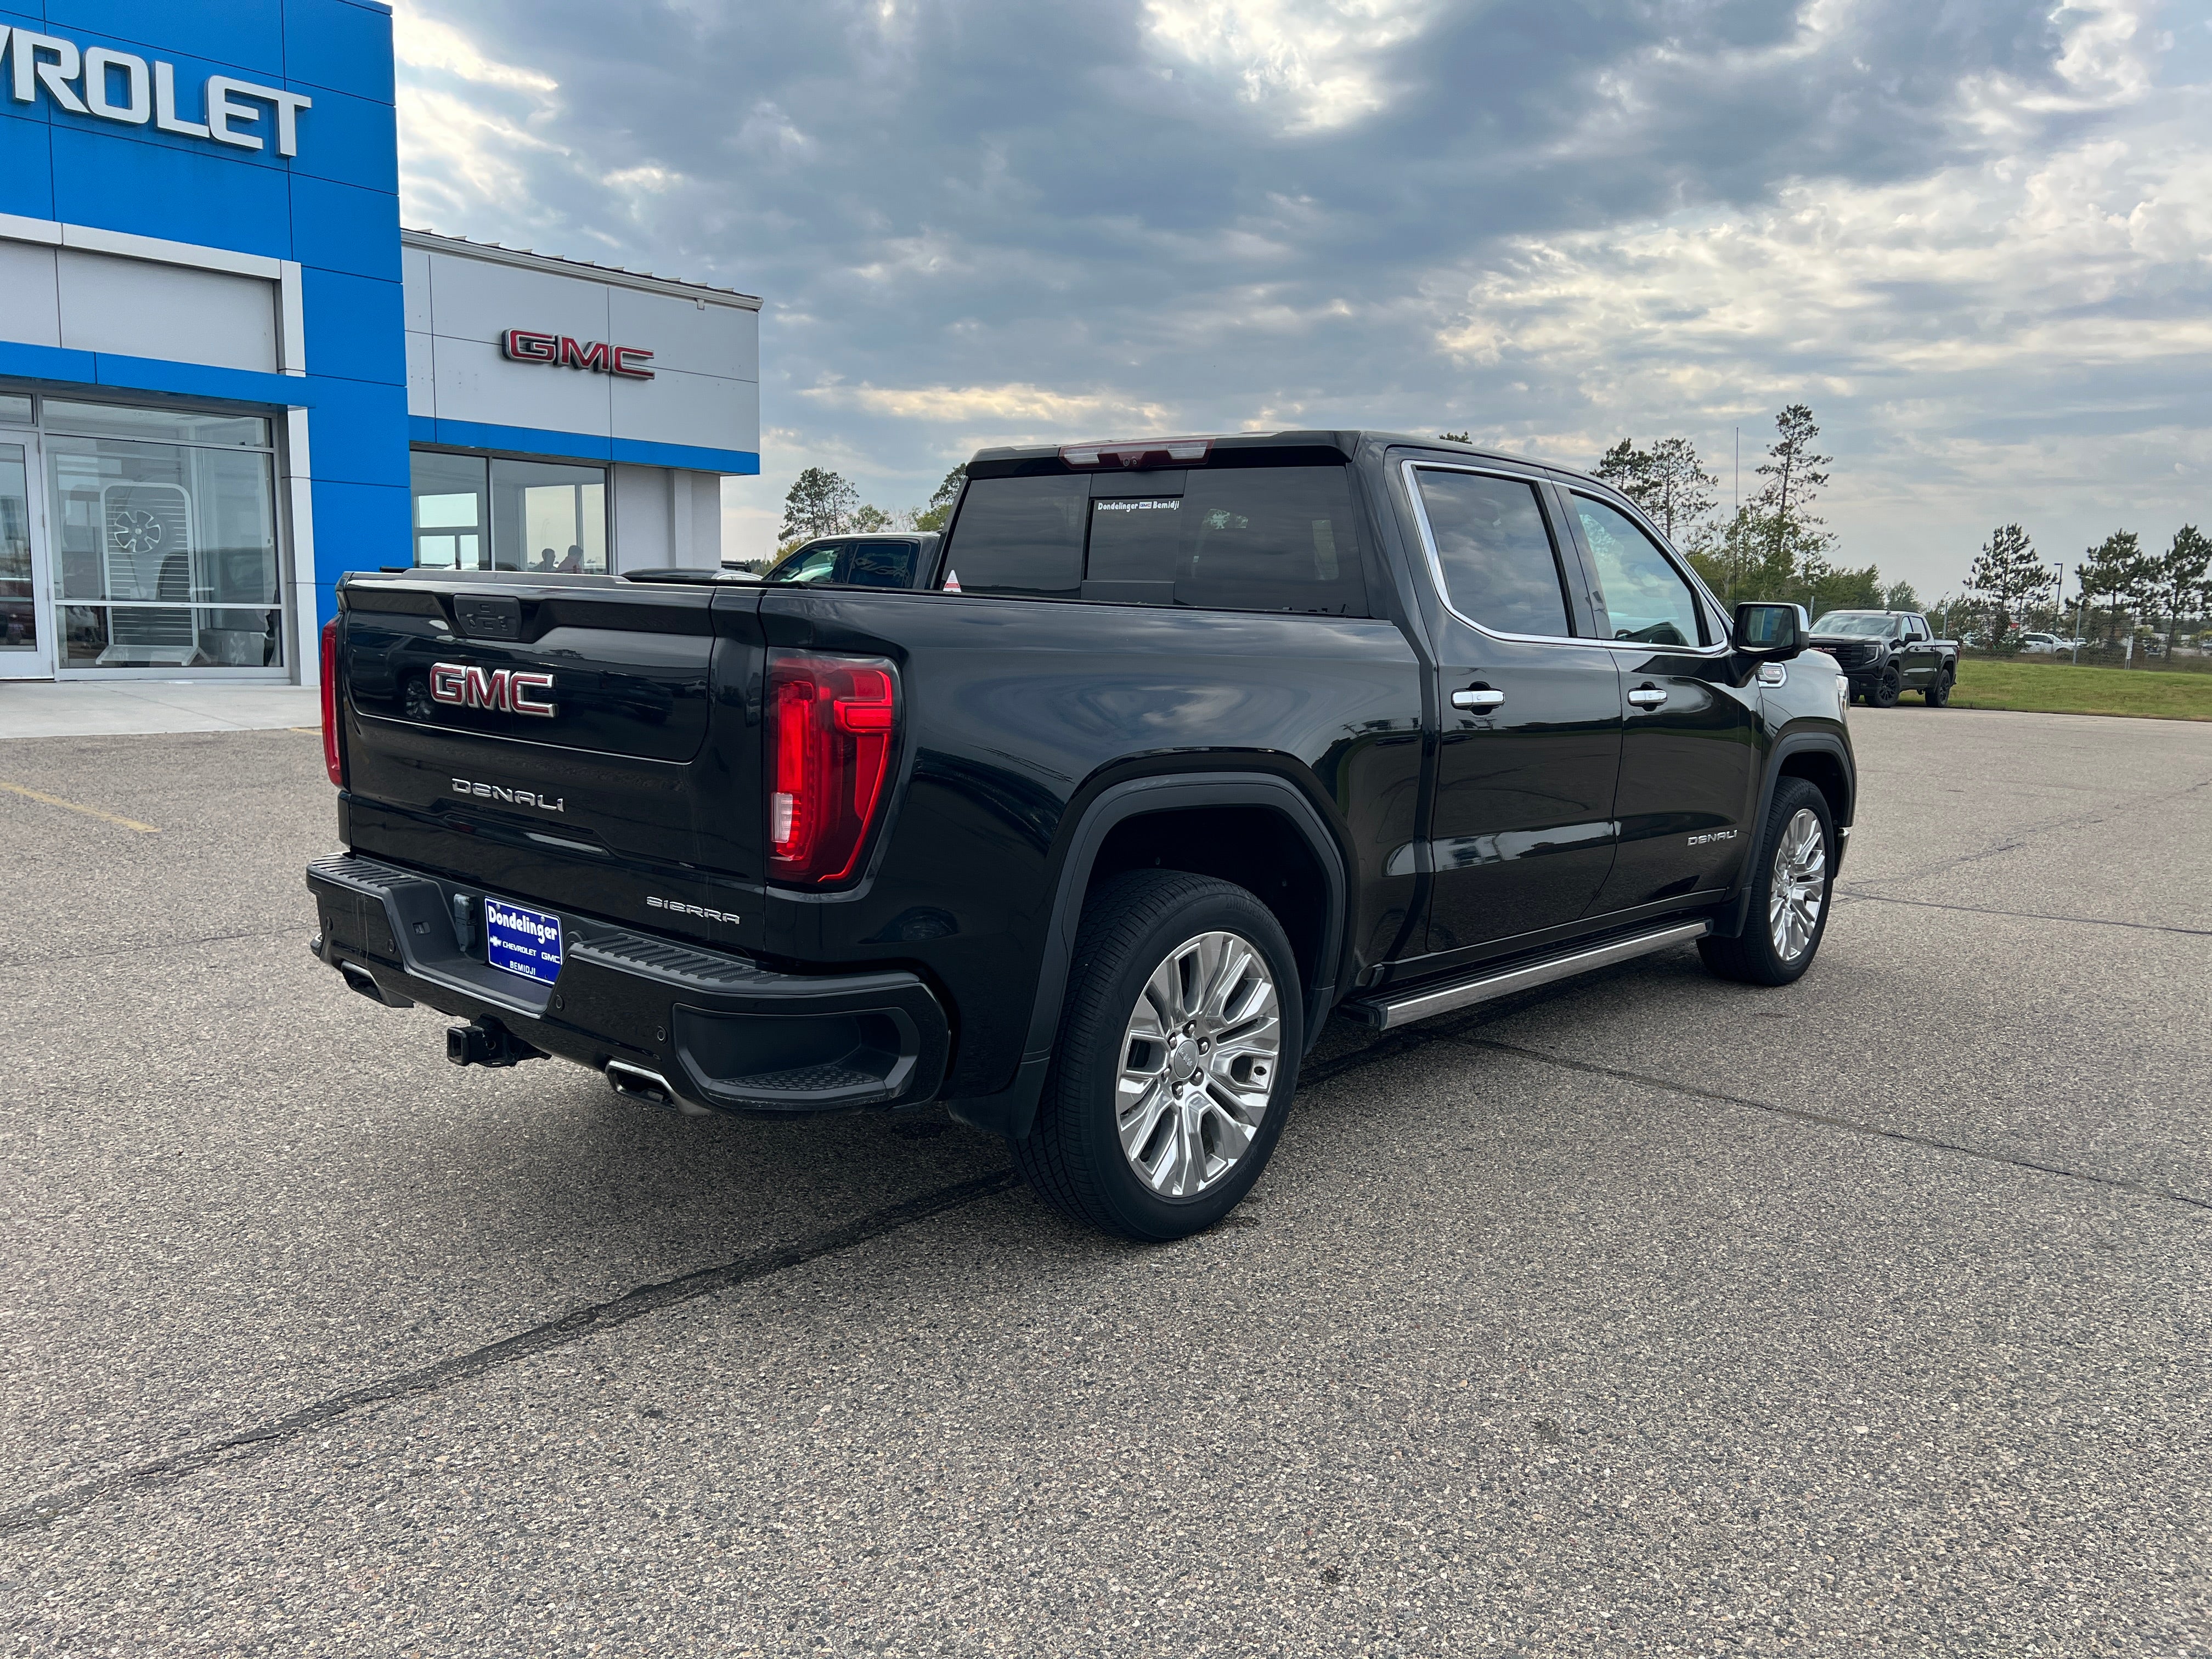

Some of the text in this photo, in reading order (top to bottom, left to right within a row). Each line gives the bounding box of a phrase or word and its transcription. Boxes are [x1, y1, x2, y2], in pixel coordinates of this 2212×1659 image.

[0, 25, 312, 157] ROLET
[502, 328, 654, 380] GMC
[1098, 501, 1138, 512] Dondelinger
[1153, 500, 1180, 510] Bemidji
[430, 662, 557, 718] GMC
[452, 778, 564, 812] DENALI
[1687, 830, 1737, 846] DENALI
[488, 905, 557, 944] Dondelinger
[646, 896, 740, 924] SIERRA
[503, 941, 560, 964] CHEVROLET GMC
[510, 961, 536, 975] BEMIDJI
